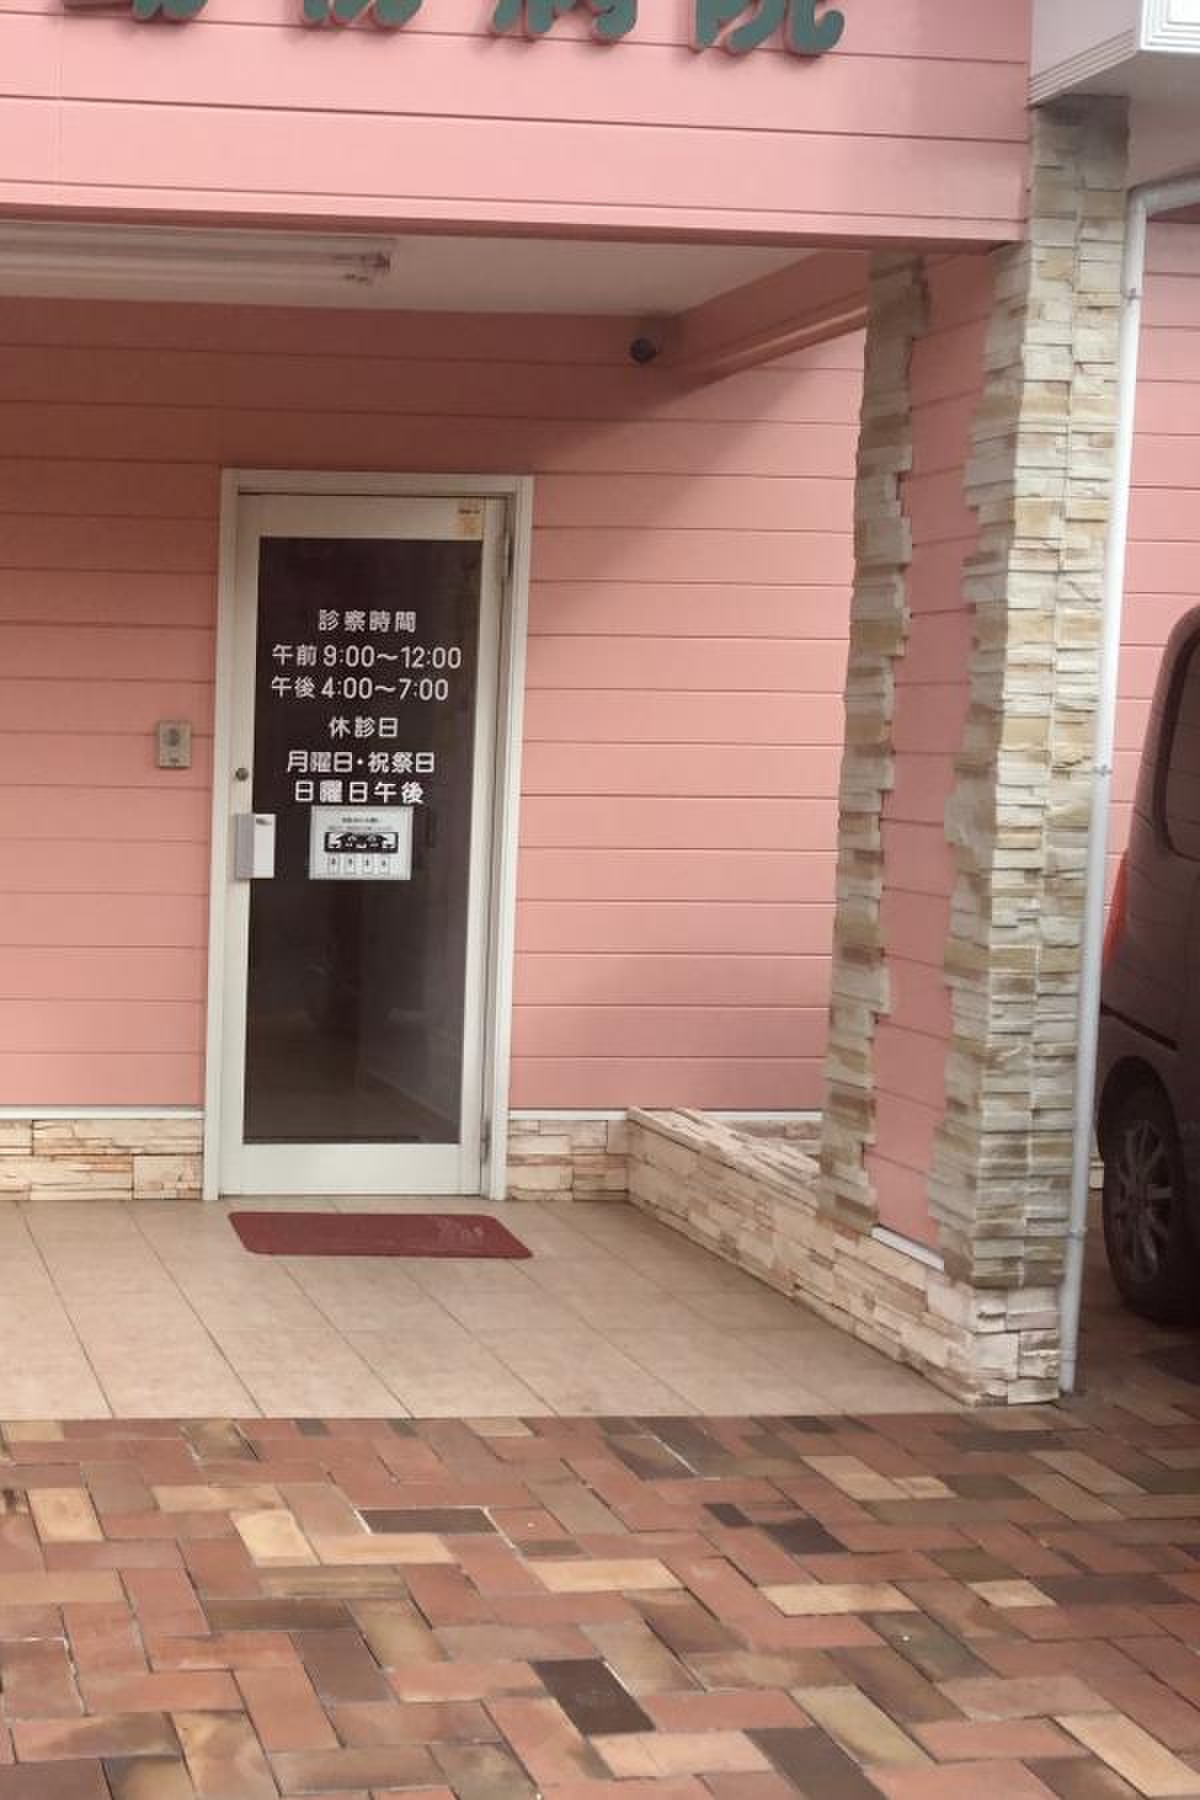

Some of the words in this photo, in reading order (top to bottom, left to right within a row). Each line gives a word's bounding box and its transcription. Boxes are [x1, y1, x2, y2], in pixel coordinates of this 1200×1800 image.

[318, 609, 417, 633] 診察時間
[328, 716, 399, 739] 休診日
[287, 750, 435, 774] 月曜日・祝祭日
[294, 779, 424, 805] 日曜日午後
